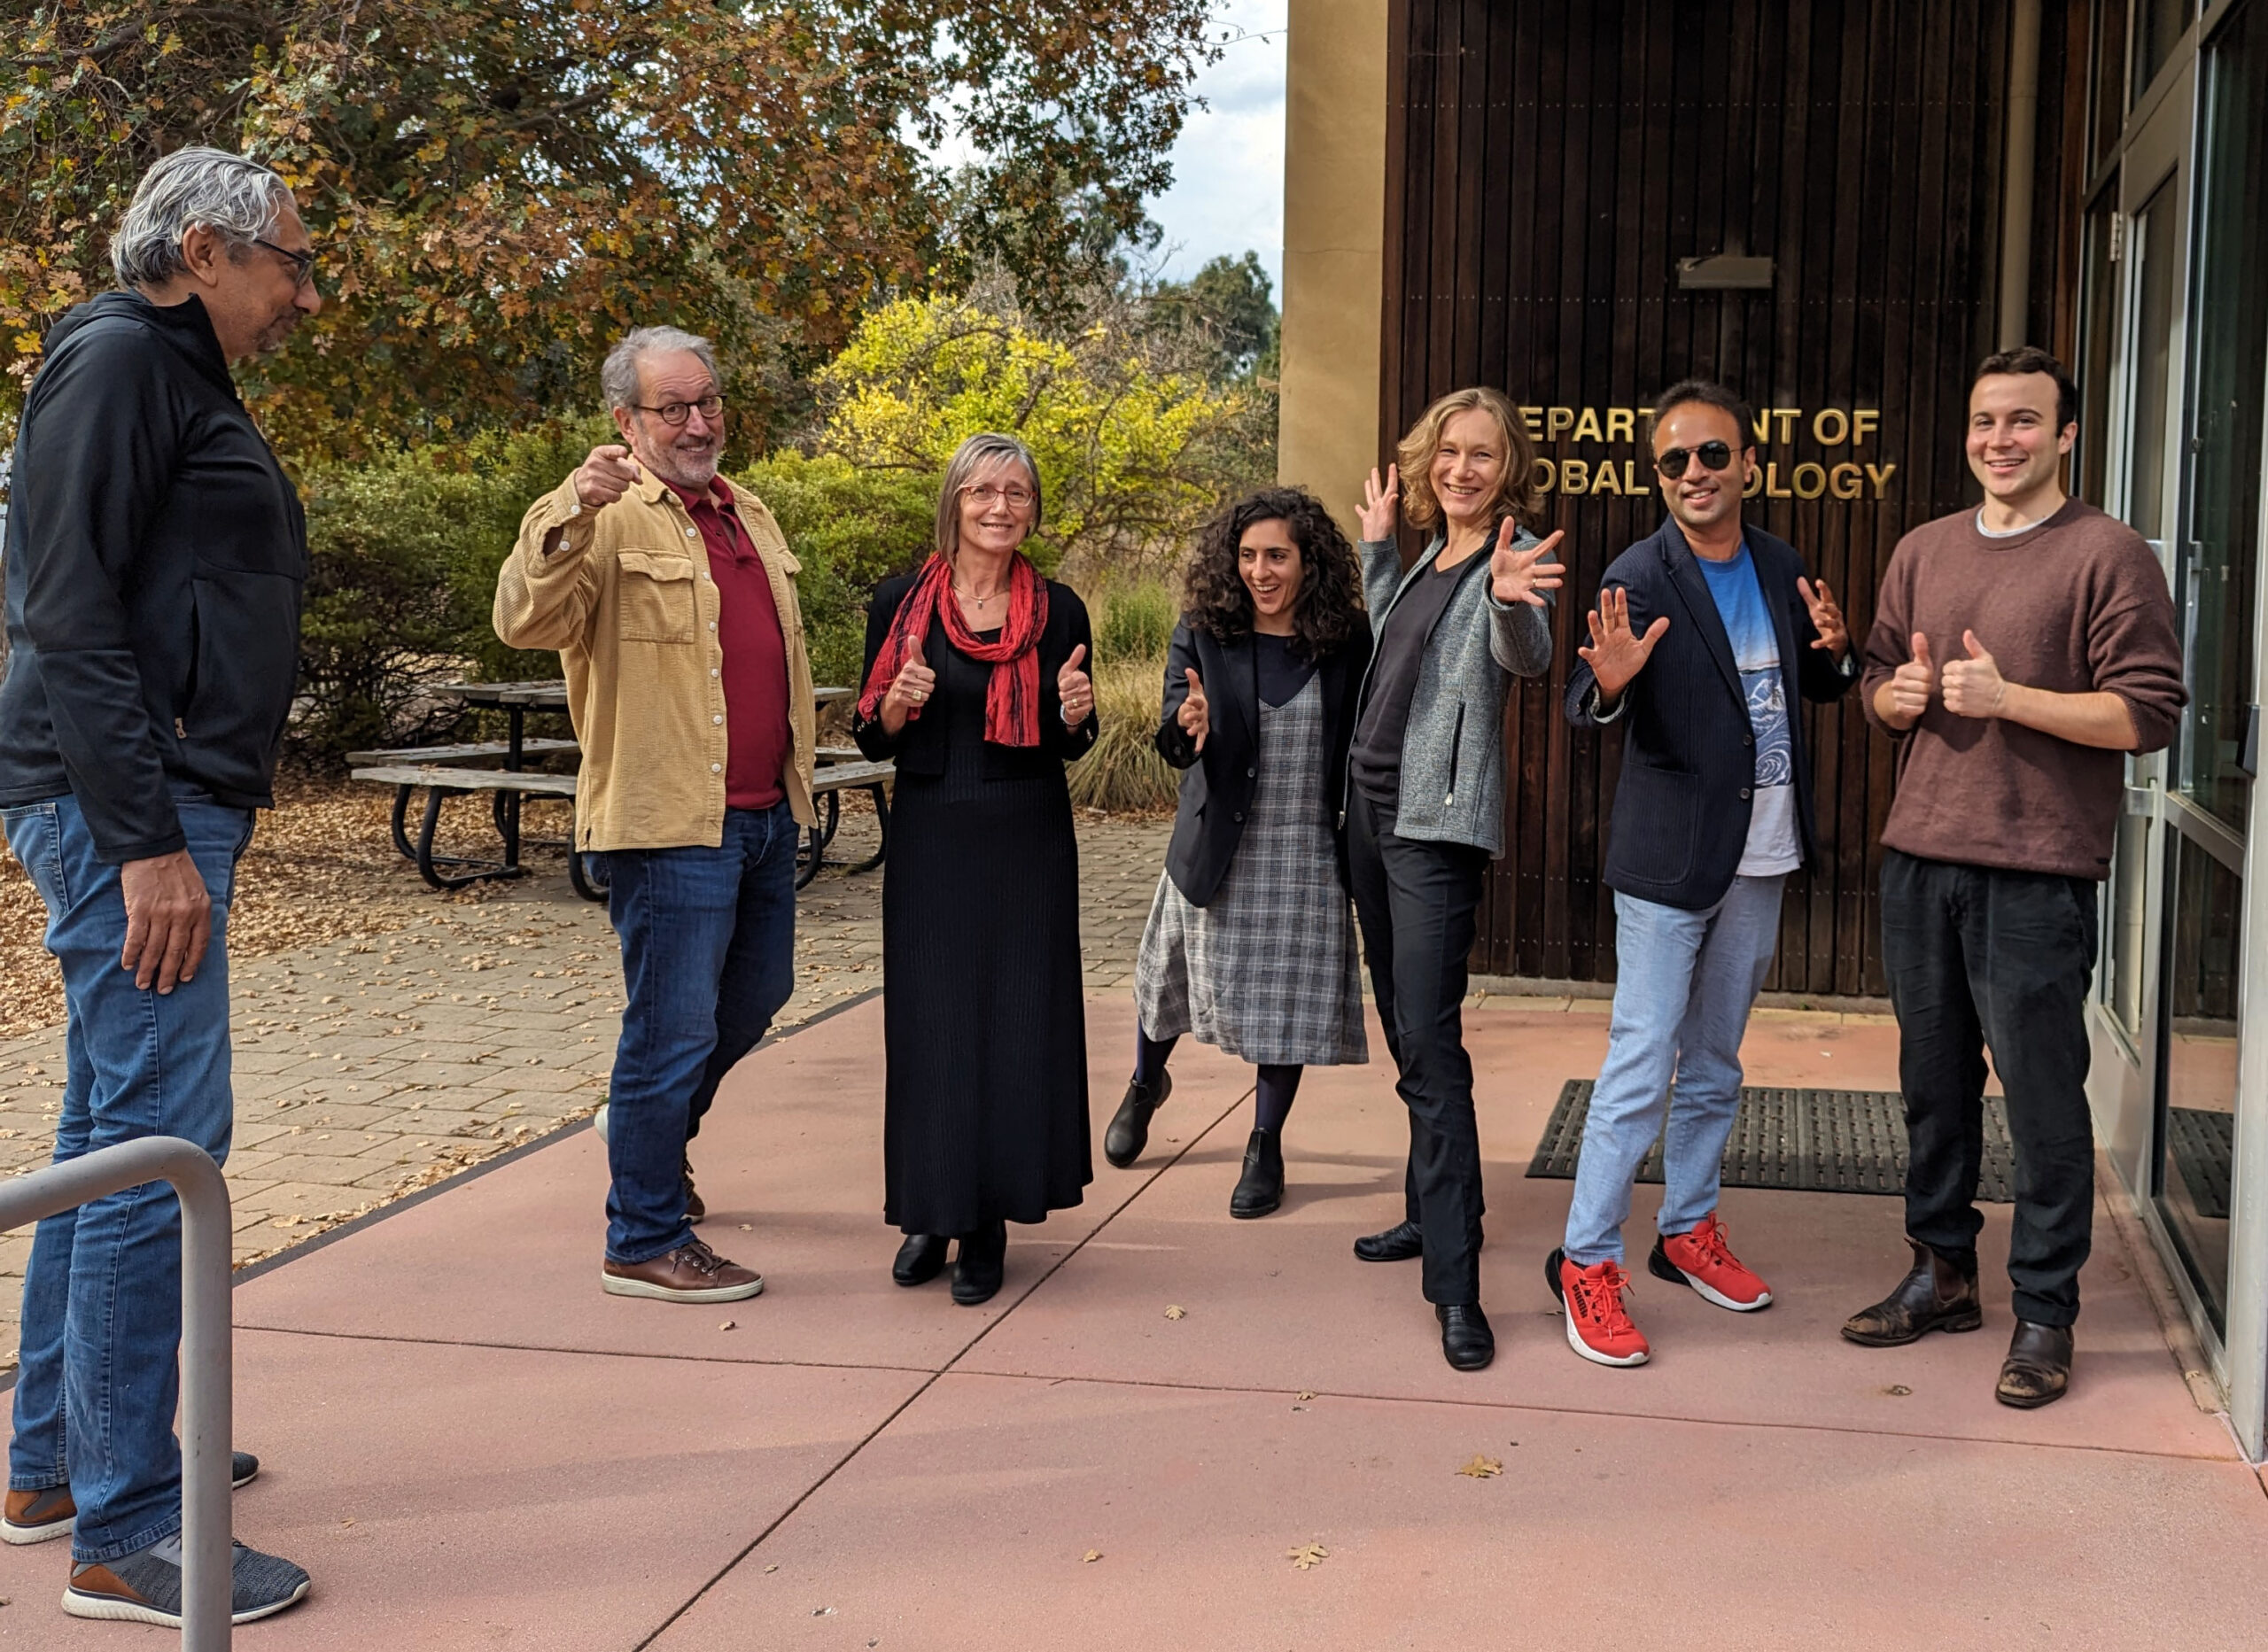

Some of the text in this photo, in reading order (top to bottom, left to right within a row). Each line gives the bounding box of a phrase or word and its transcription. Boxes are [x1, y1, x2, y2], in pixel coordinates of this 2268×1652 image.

[1813, 407, 1880, 446] OF
[1531, 457, 1897, 500] OBAL OLOGY
[1573, 1284, 1588, 1318] PUMA
